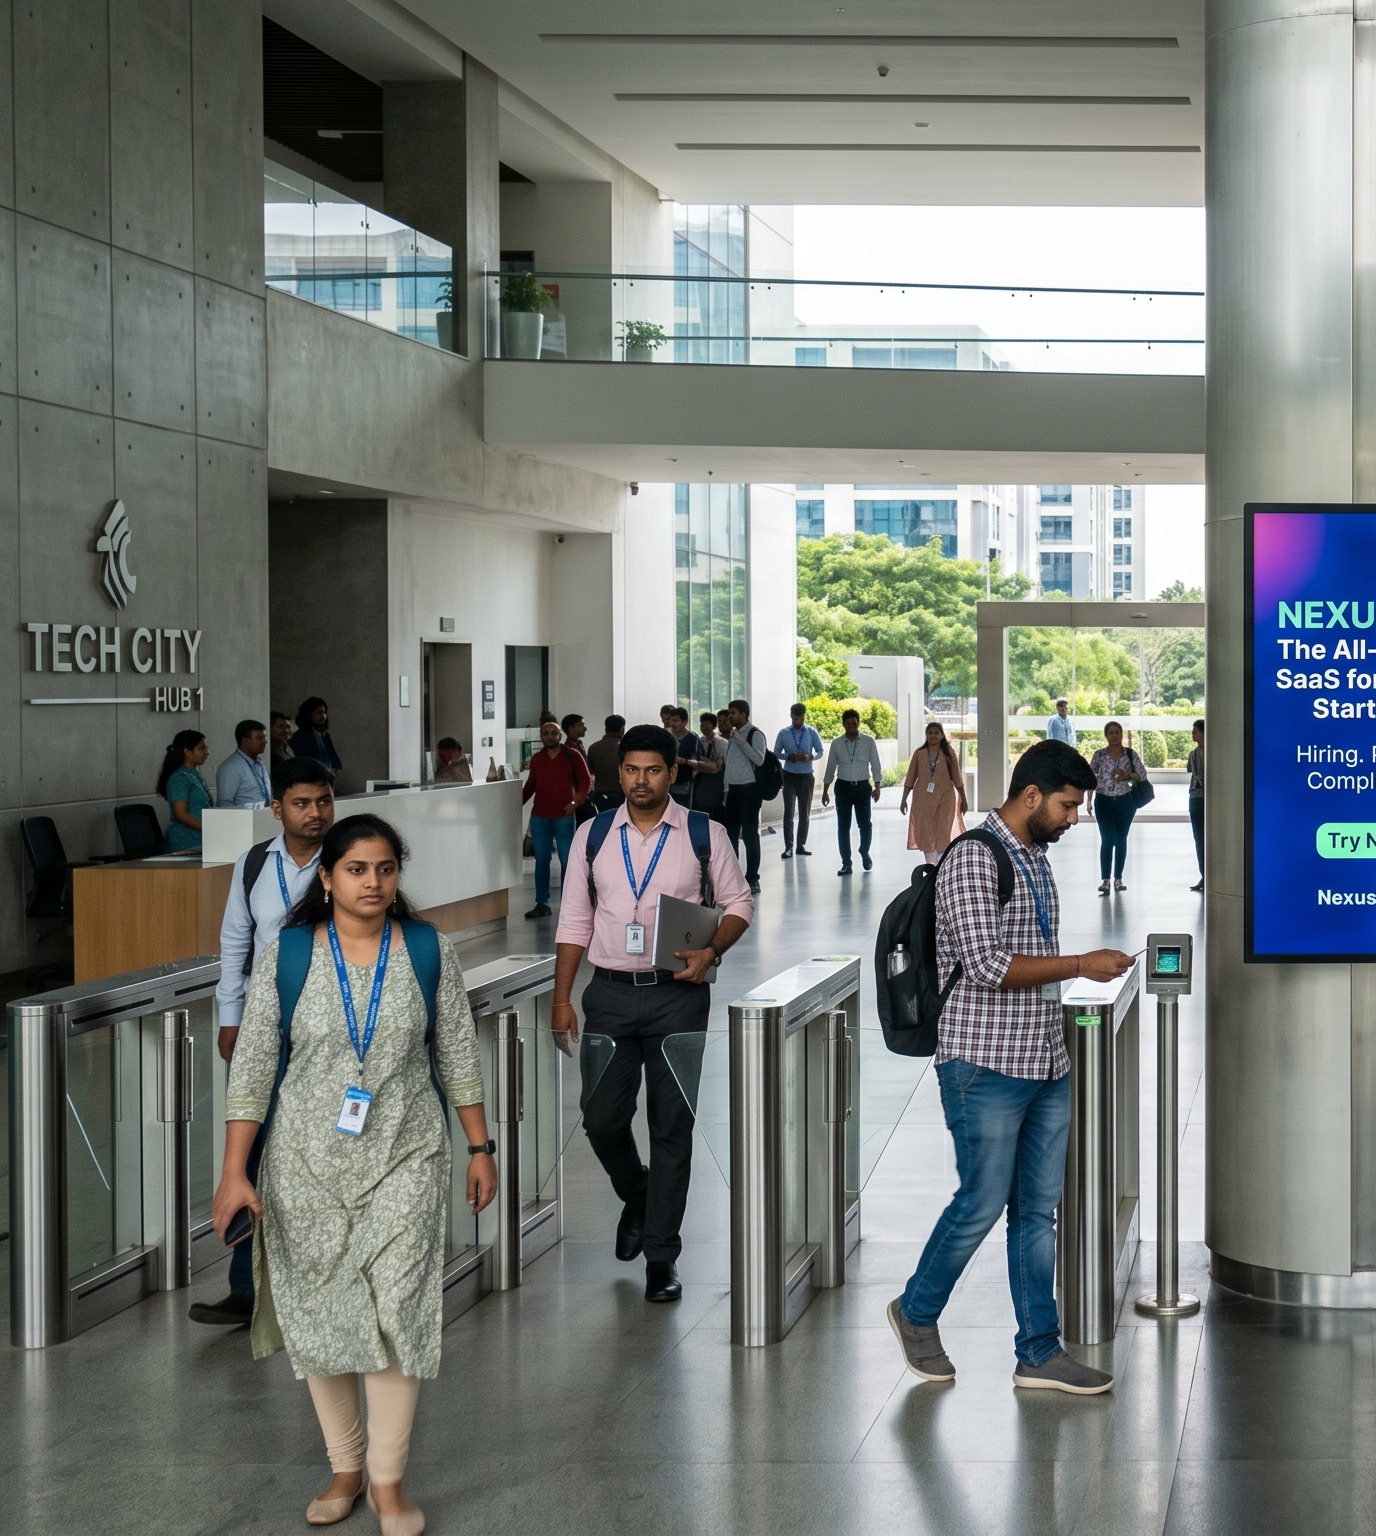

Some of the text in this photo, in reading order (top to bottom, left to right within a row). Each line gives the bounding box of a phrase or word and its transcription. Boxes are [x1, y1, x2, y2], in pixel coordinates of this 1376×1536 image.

[27, 622, 202, 674] TECH CITY
[1276, 638, 1327, 660] The
[1275, 668, 1341, 690] SaaS
[155, 686, 204, 712] HUB 1
[1297, 744, 1364, 768] Hiring.
[1327, 832, 1361, 853] Try
